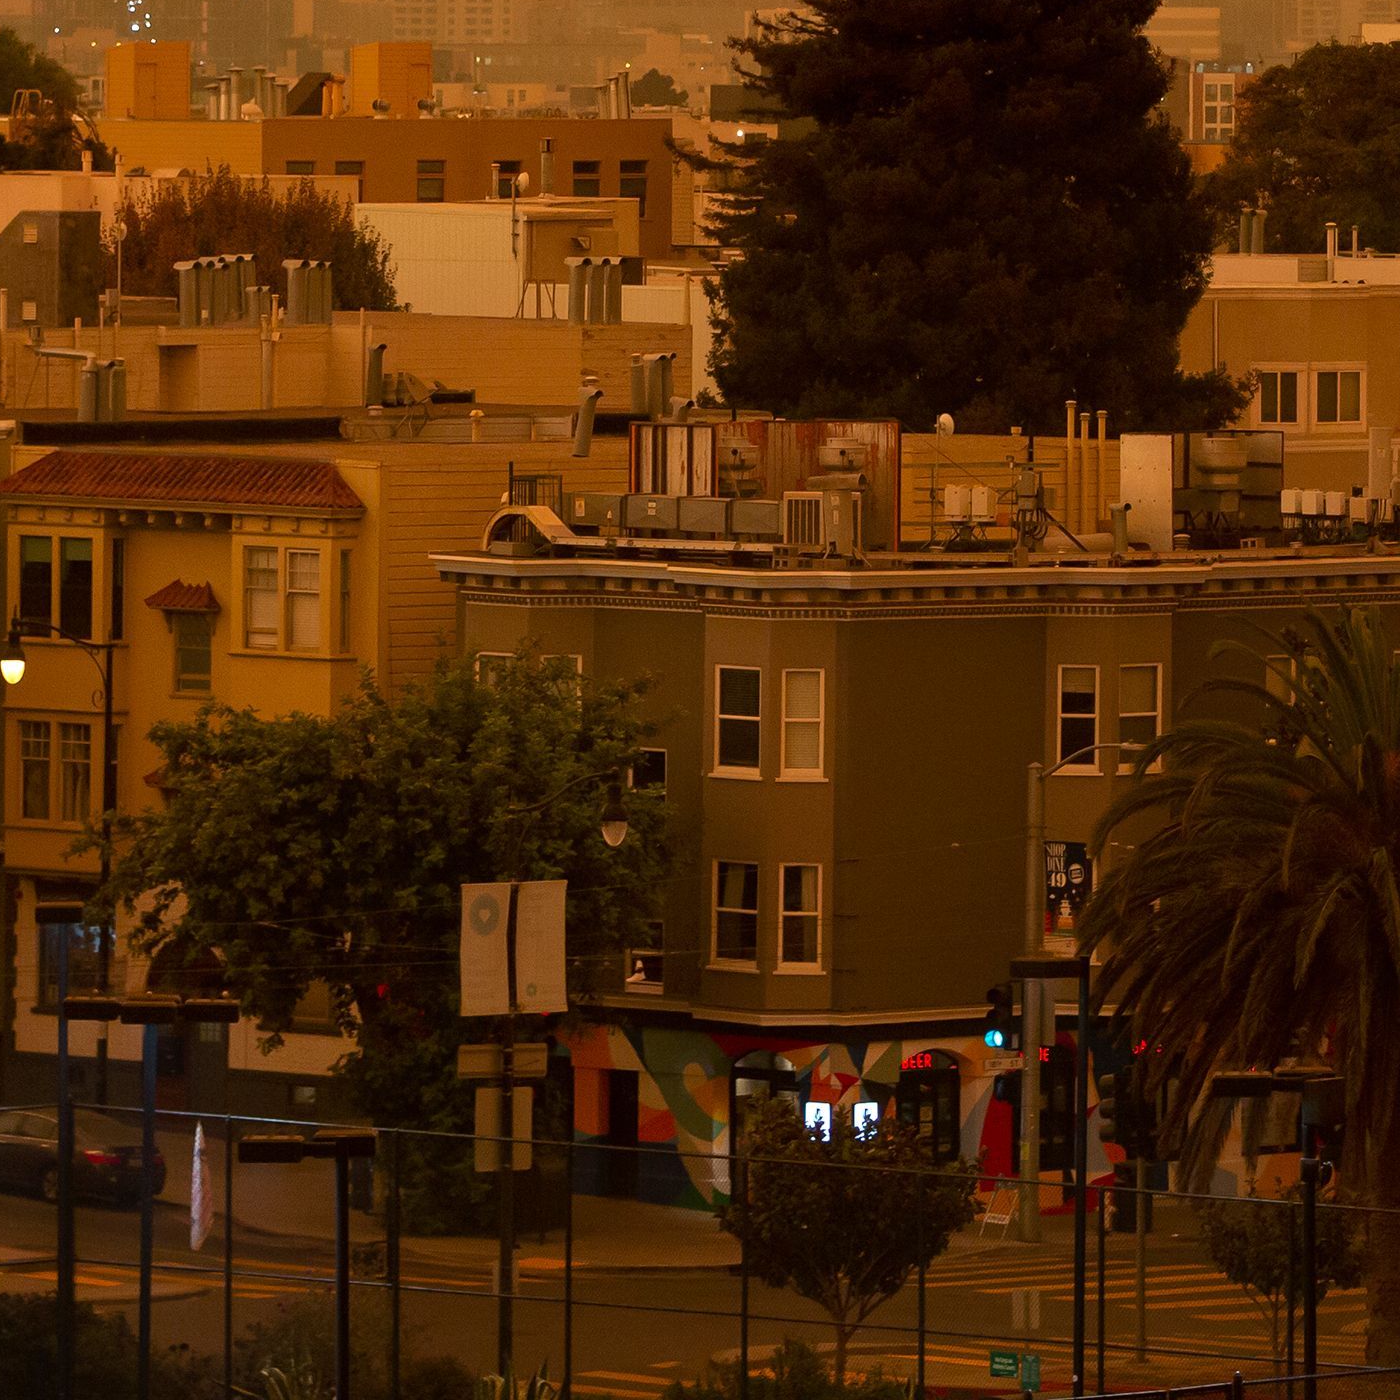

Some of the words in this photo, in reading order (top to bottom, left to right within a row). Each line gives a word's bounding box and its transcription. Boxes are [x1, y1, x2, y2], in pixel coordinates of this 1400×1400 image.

[1046, 843, 1066, 856] SHOP
[1046, 857, 1066, 872] DINE
[1048, 872, 1067, 888] 49
[901, 1053, 932, 1070] BEER
